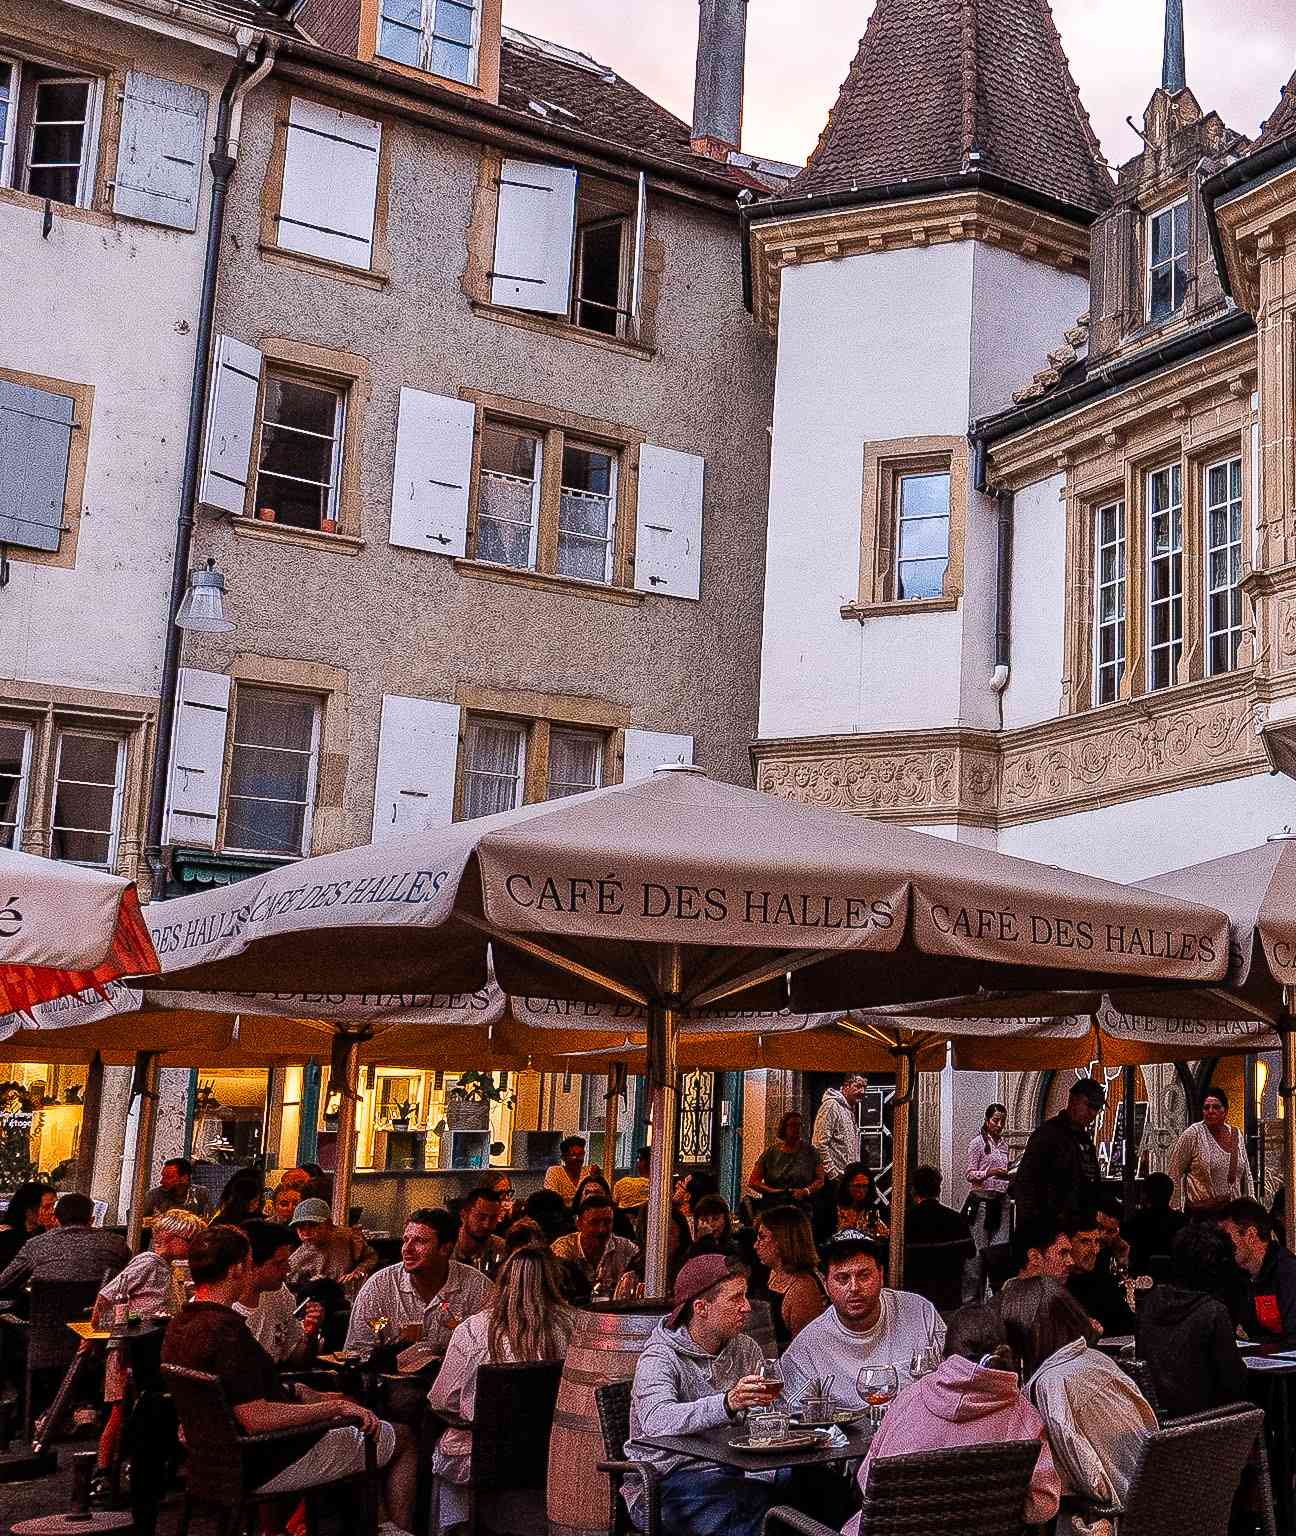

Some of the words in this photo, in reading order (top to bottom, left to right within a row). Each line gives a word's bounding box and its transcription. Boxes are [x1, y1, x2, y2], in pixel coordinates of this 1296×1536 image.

[249, 884, 305, 923] CAFÉ
[297, 880, 349, 911] DES
[343, 871, 449, 905] HALLES
[505, 872, 625, 915] CAFÉ
[641, 882, 728, 921] DES
[743, 890, 896, 930] HALLES
[930, 905, 1019, 942] CAFÉ
[1030, 915, 1094, 950] DES
[1105, 924, 1216, 963] HALLES
